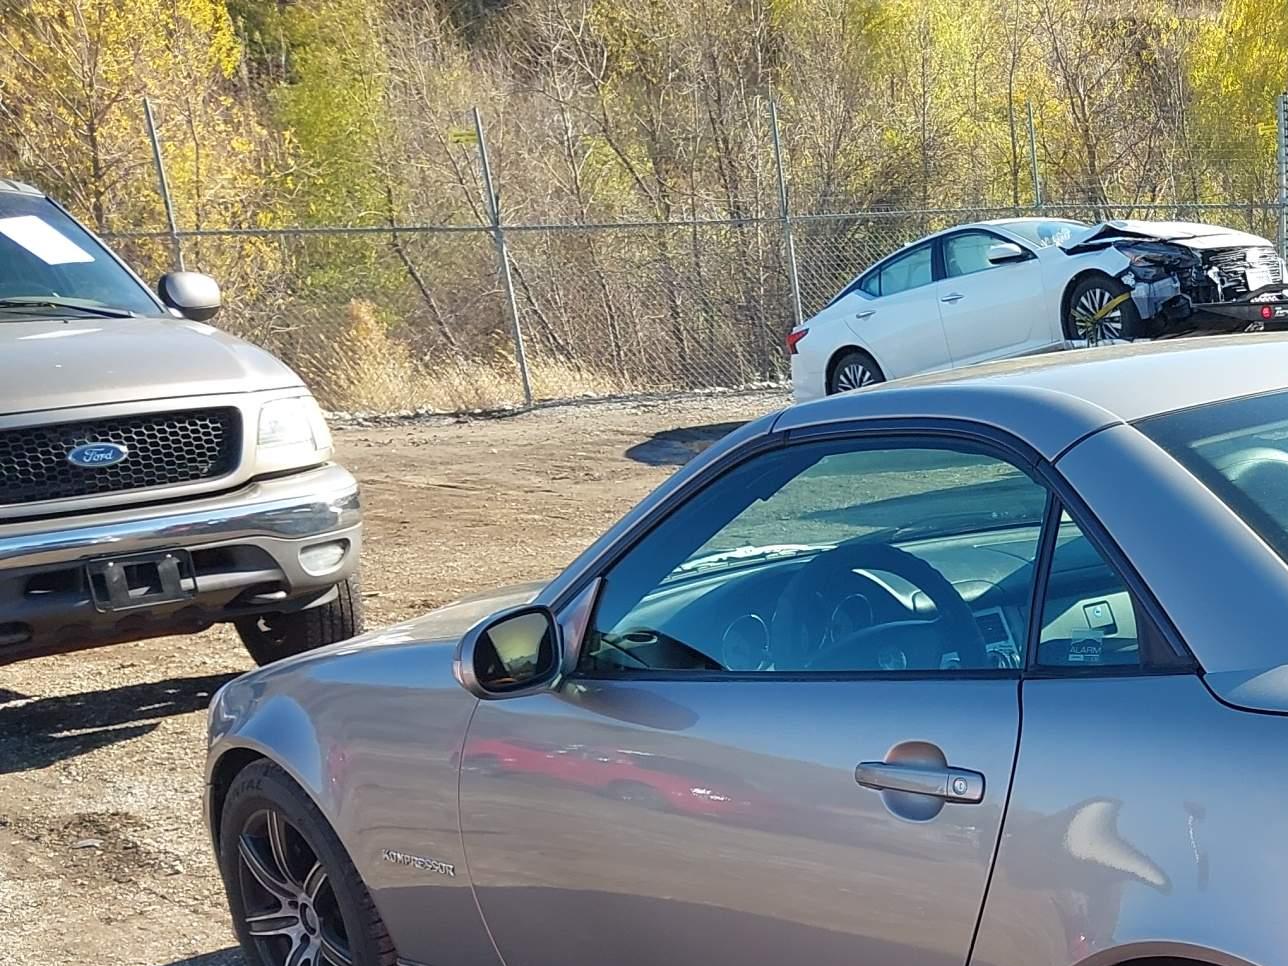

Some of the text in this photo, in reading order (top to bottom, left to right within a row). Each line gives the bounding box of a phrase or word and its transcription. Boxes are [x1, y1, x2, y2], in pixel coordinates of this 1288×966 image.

[83, 448, 113, 462] Ford
[1069, 646, 1102, 654] ALARM
[382, 848, 456, 877] KOMPRESSOR
